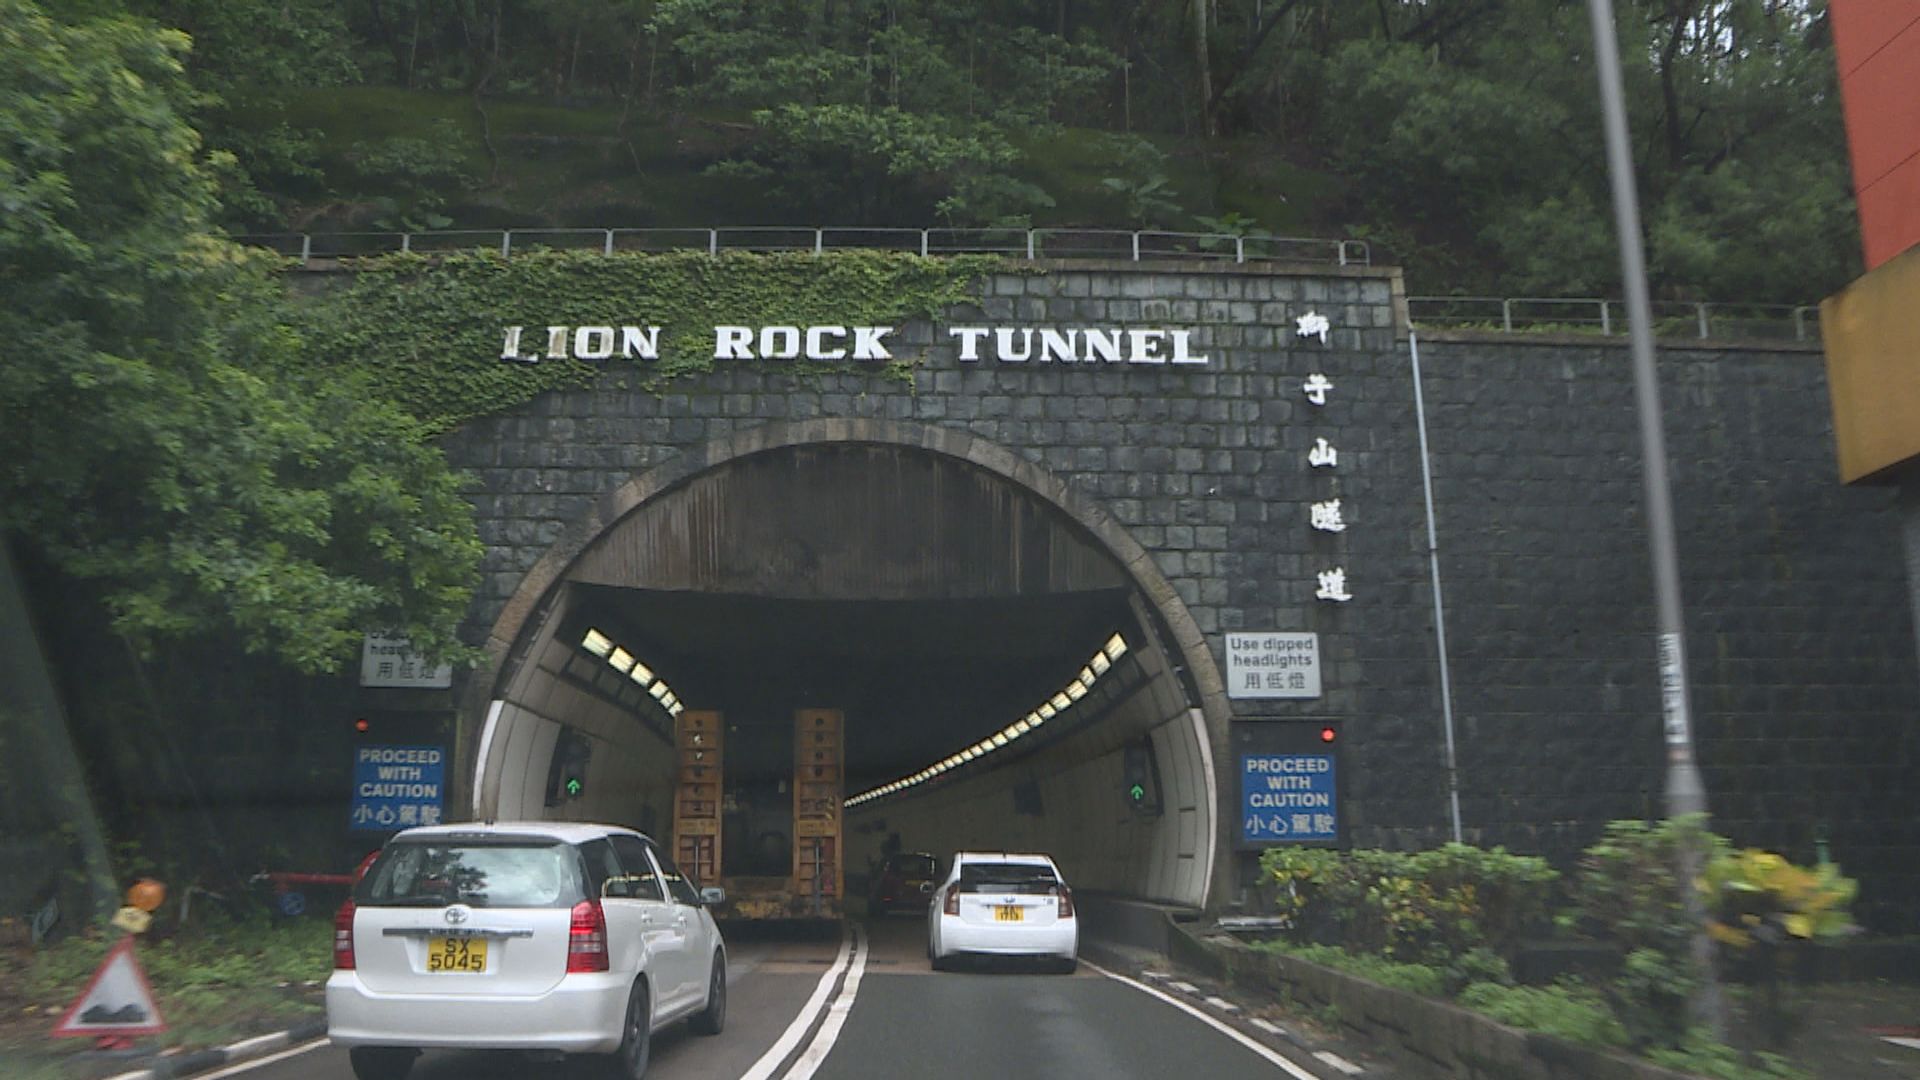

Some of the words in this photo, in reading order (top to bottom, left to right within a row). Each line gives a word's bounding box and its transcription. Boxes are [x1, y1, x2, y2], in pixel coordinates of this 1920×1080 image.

[501, 326, 661, 362] LION
[714, 325, 894, 360] ROCK
[949, 327, 1209, 363] TUNNEL
[1296, 311, 1352, 601] 獅子山隧道
[1230, 637, 1259, 650] Use
[1263, 637, 1313, 651] dipped
[1233, 654, 1312, 668] headlights
[1244, 672, 1305, 689] 用低燈
[360, 749, 440, 764] PROCEED
[378, 766, 421, 780] WITH
[1246, 758, 1330, 773] PROCEED
[360, 783, 437, 798] CAUTION
[1266, 776, 1311, 790] WITH
[1250, 793, 1329, 808] CAUTION
[353, 804, 441, 827] 小心駕駛
[1246, 814, 1335, 835] 小心駕駛
[445, 938, 471, 954] SX
[430, 953, 483, 970] 5045
